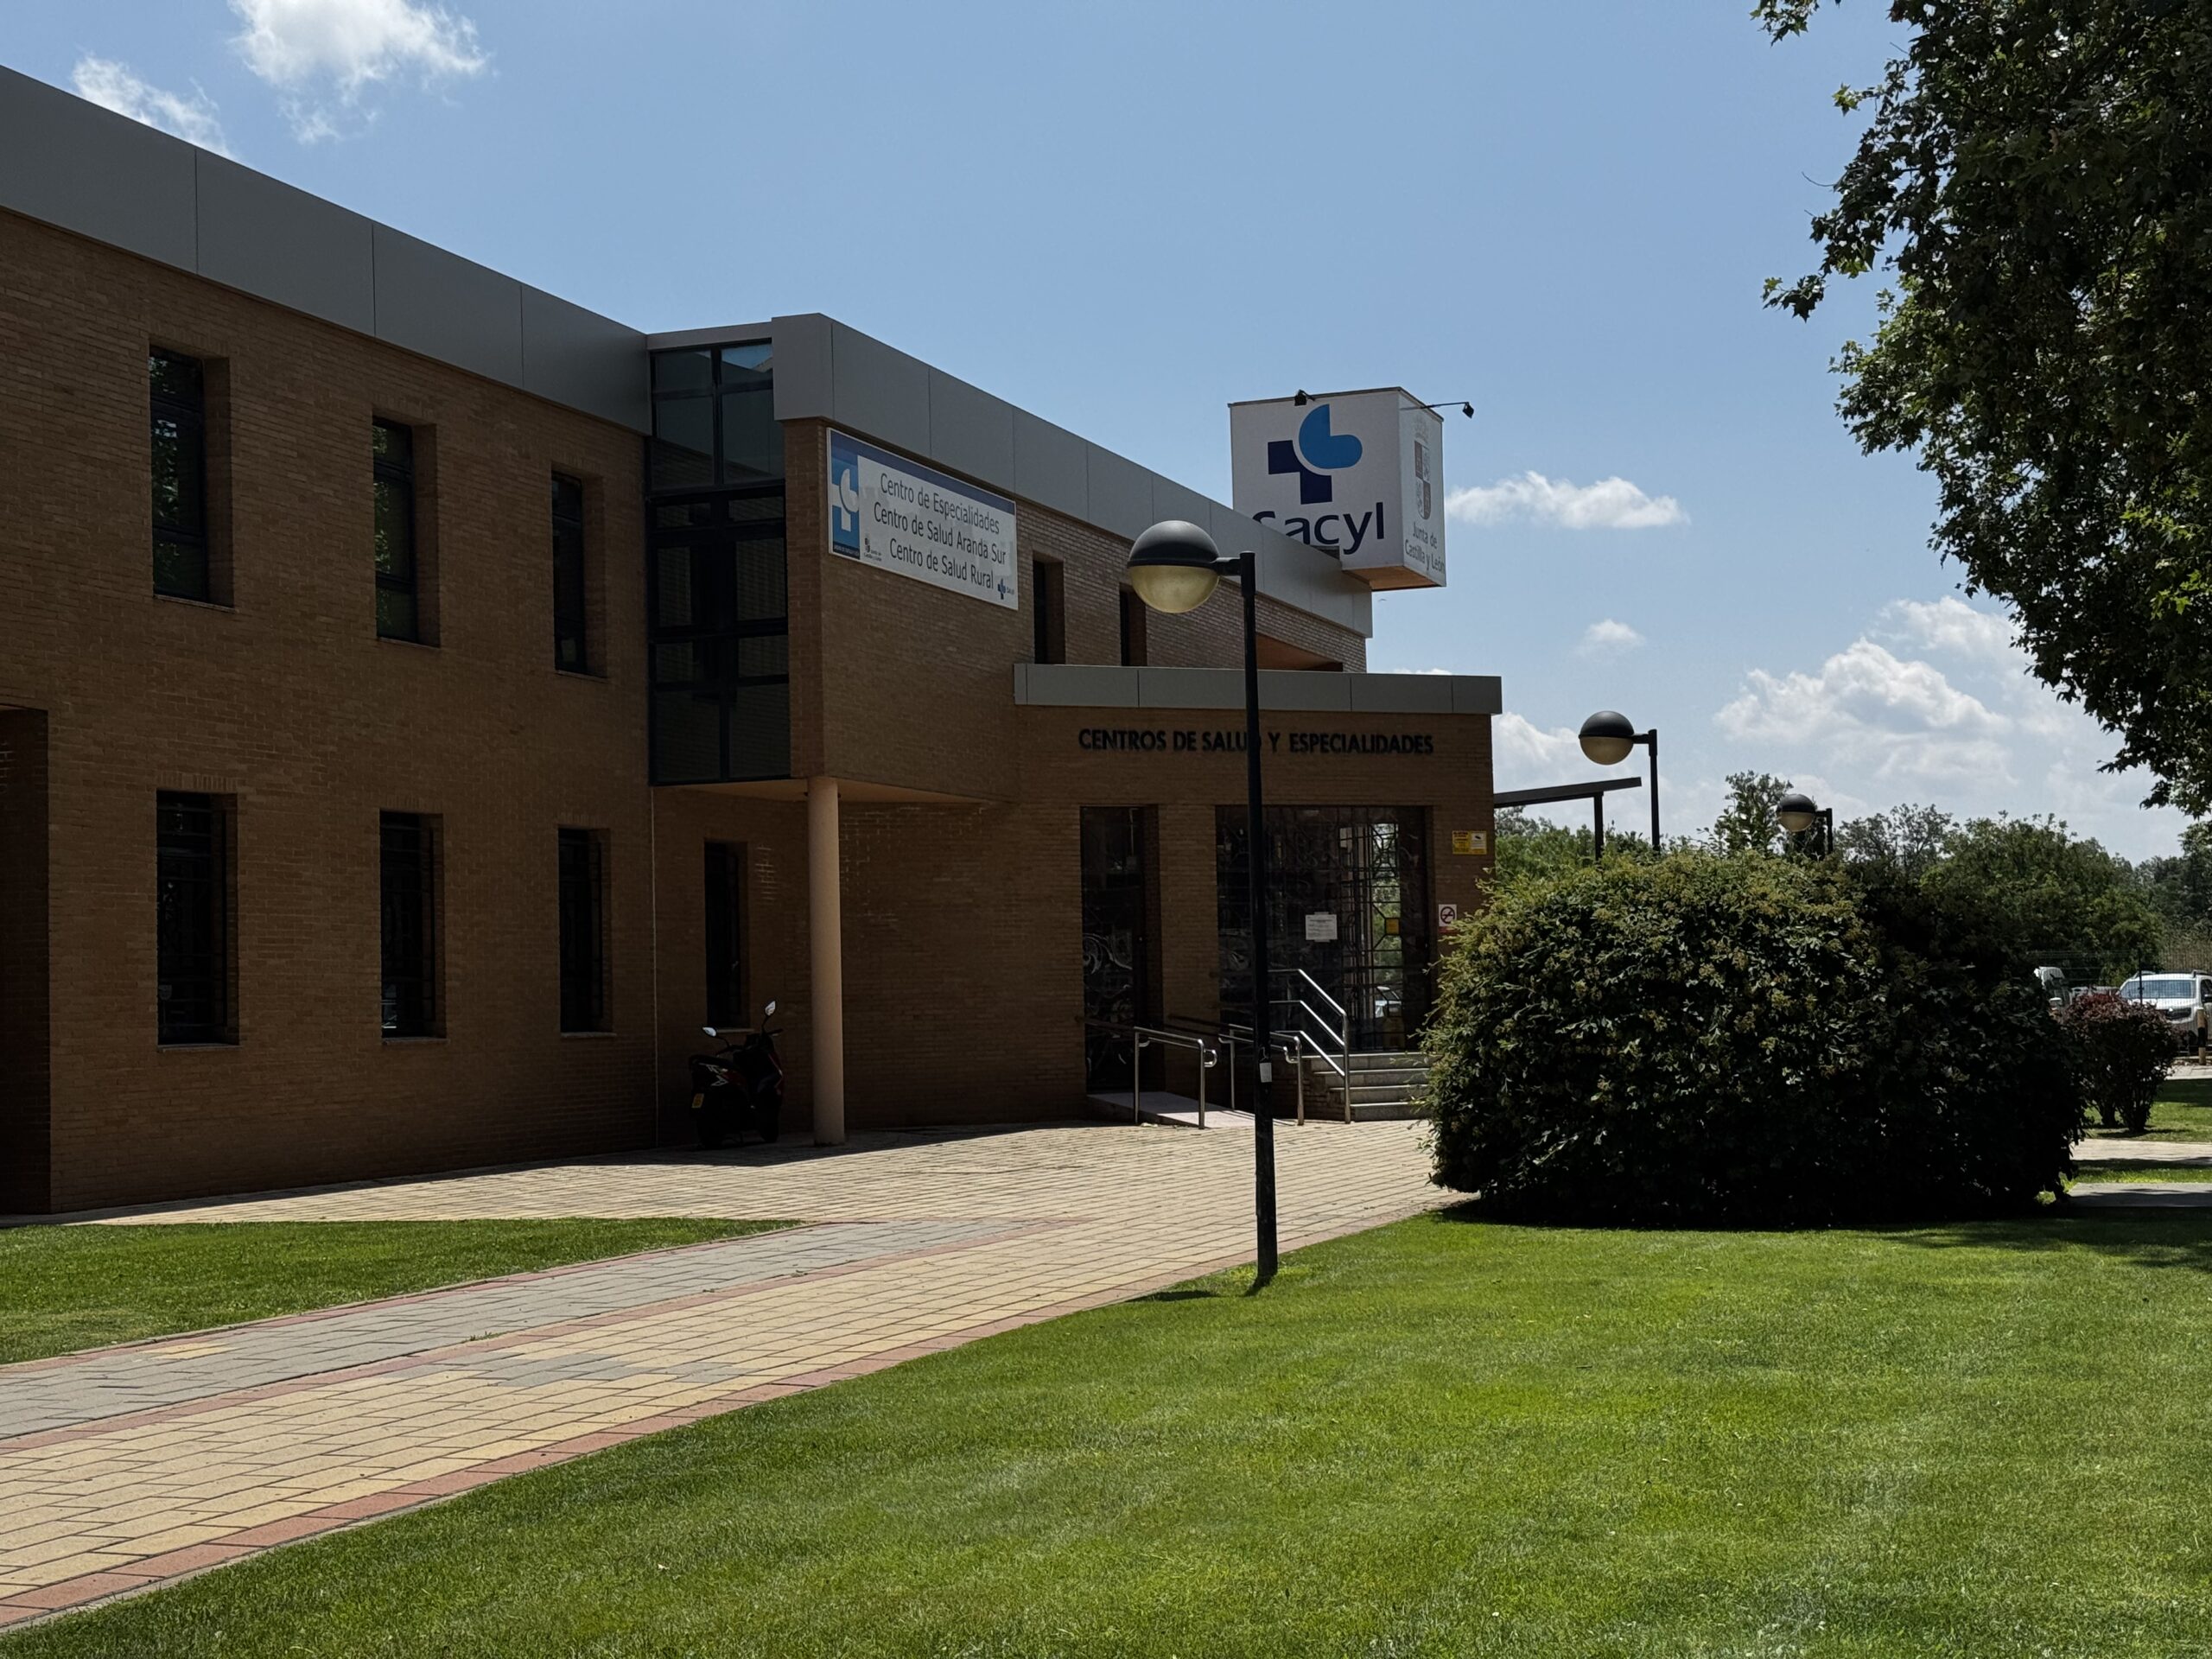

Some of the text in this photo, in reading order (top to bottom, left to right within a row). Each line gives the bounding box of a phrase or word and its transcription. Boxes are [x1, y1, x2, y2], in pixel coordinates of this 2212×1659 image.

[880, 473, 1000, 535] Centro de Especialidades
[874, 501, 1007, 564] Centro de Salud Aranda Sur
[1413, 521, 1437, 550] Junta de
[890, 537, 923, 567] Centro
[926, 550, 938, 572] de
[941, 555, 968, 581] Salud
[970, 564, 994, 589] Rural
[1078, 728, 1434, 754] CENTROS DE SALU Y ESPECIALIDADES
